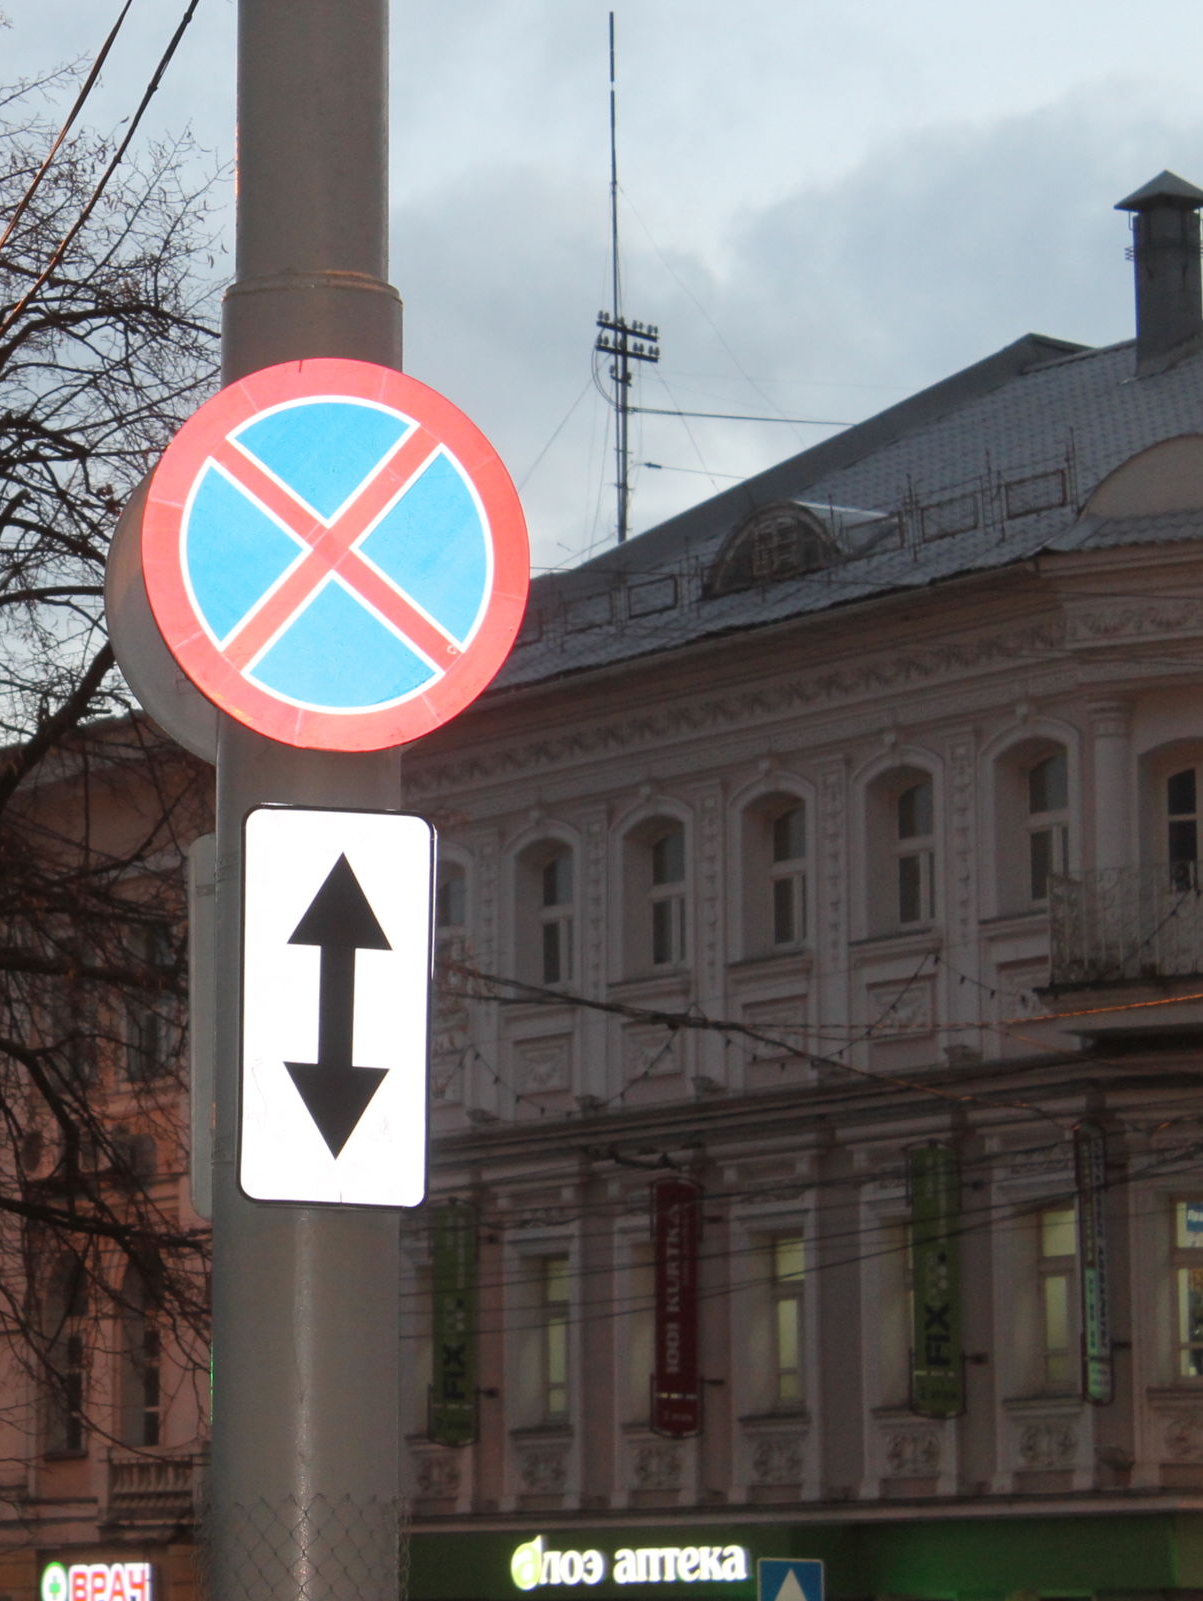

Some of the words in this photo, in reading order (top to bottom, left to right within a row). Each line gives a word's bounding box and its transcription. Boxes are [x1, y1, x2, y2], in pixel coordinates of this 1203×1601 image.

[665, 1203, 682, 1313] KURTKA
[923, 1303, 951, 1367] FIX
[442, 1343, 467, 1400] FIX
[71, 1566, 149, 1601] ВРАЧ
[613, 1543, 747, 1585] аптека
